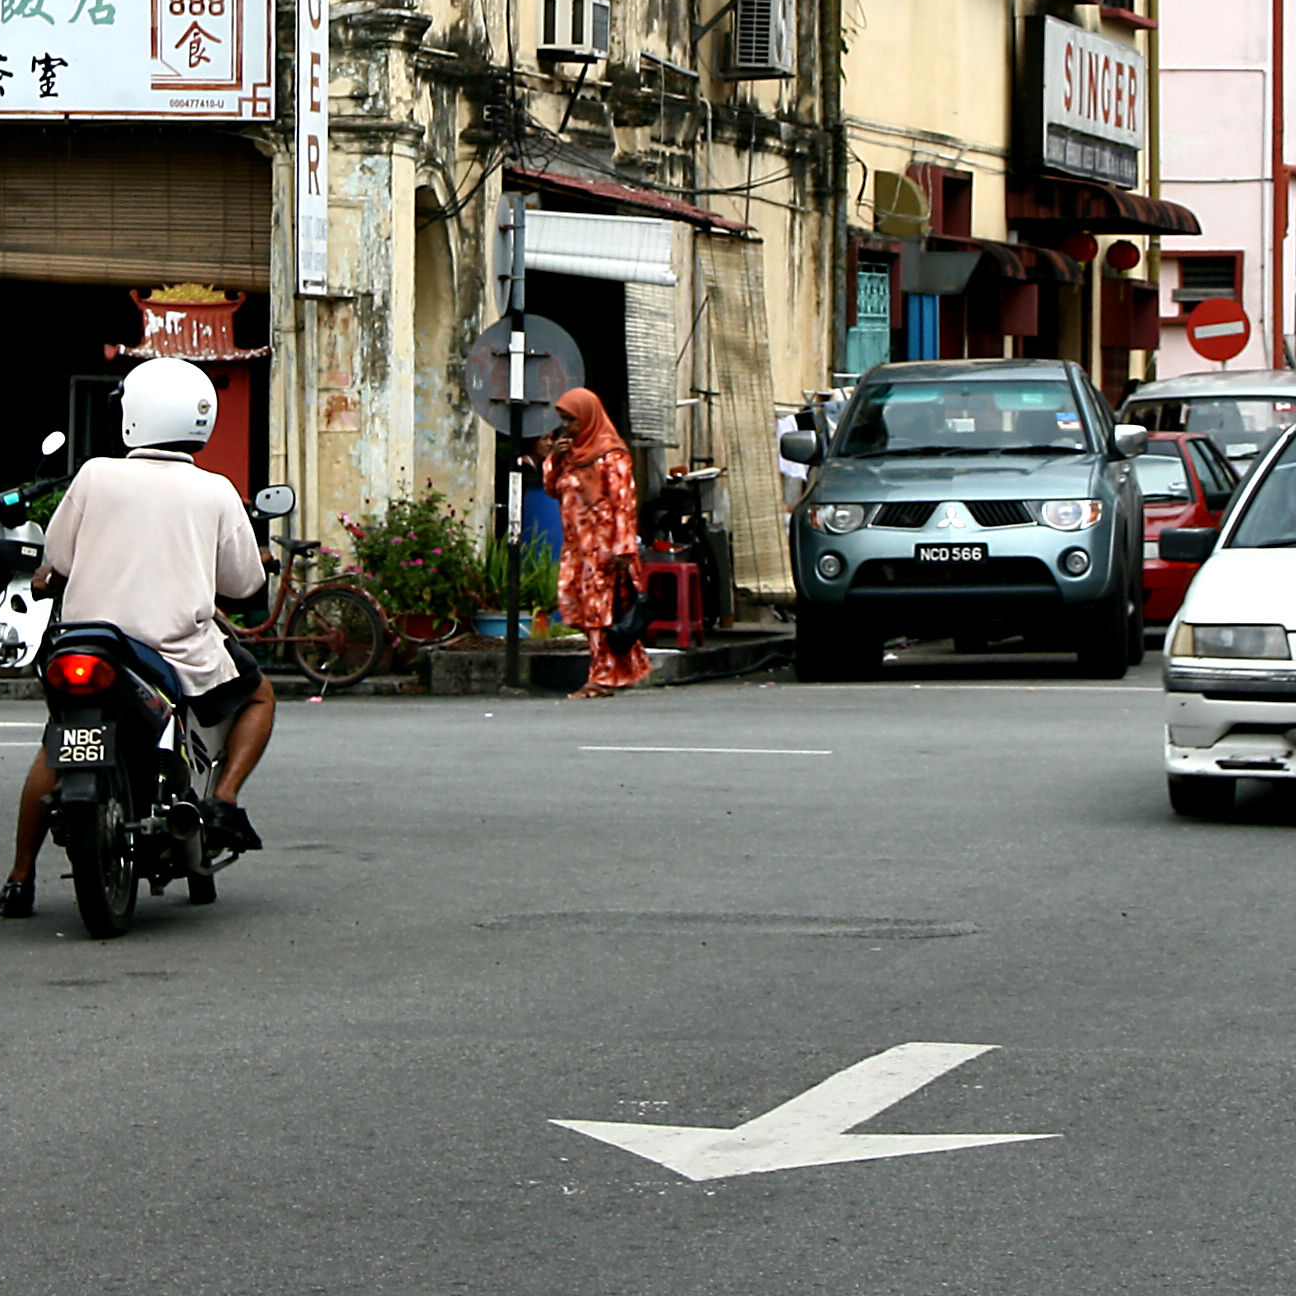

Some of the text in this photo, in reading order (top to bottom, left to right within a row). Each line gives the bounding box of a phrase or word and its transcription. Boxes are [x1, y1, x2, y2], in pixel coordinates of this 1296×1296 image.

[174, 20, 222, 68] 食
[1064, 42, 1137, 132] SINGER
[920, 547, 982, 561] NCD 566
[63, 729, 102, 745] NBC
[59, 745, 104, 762] 2661
